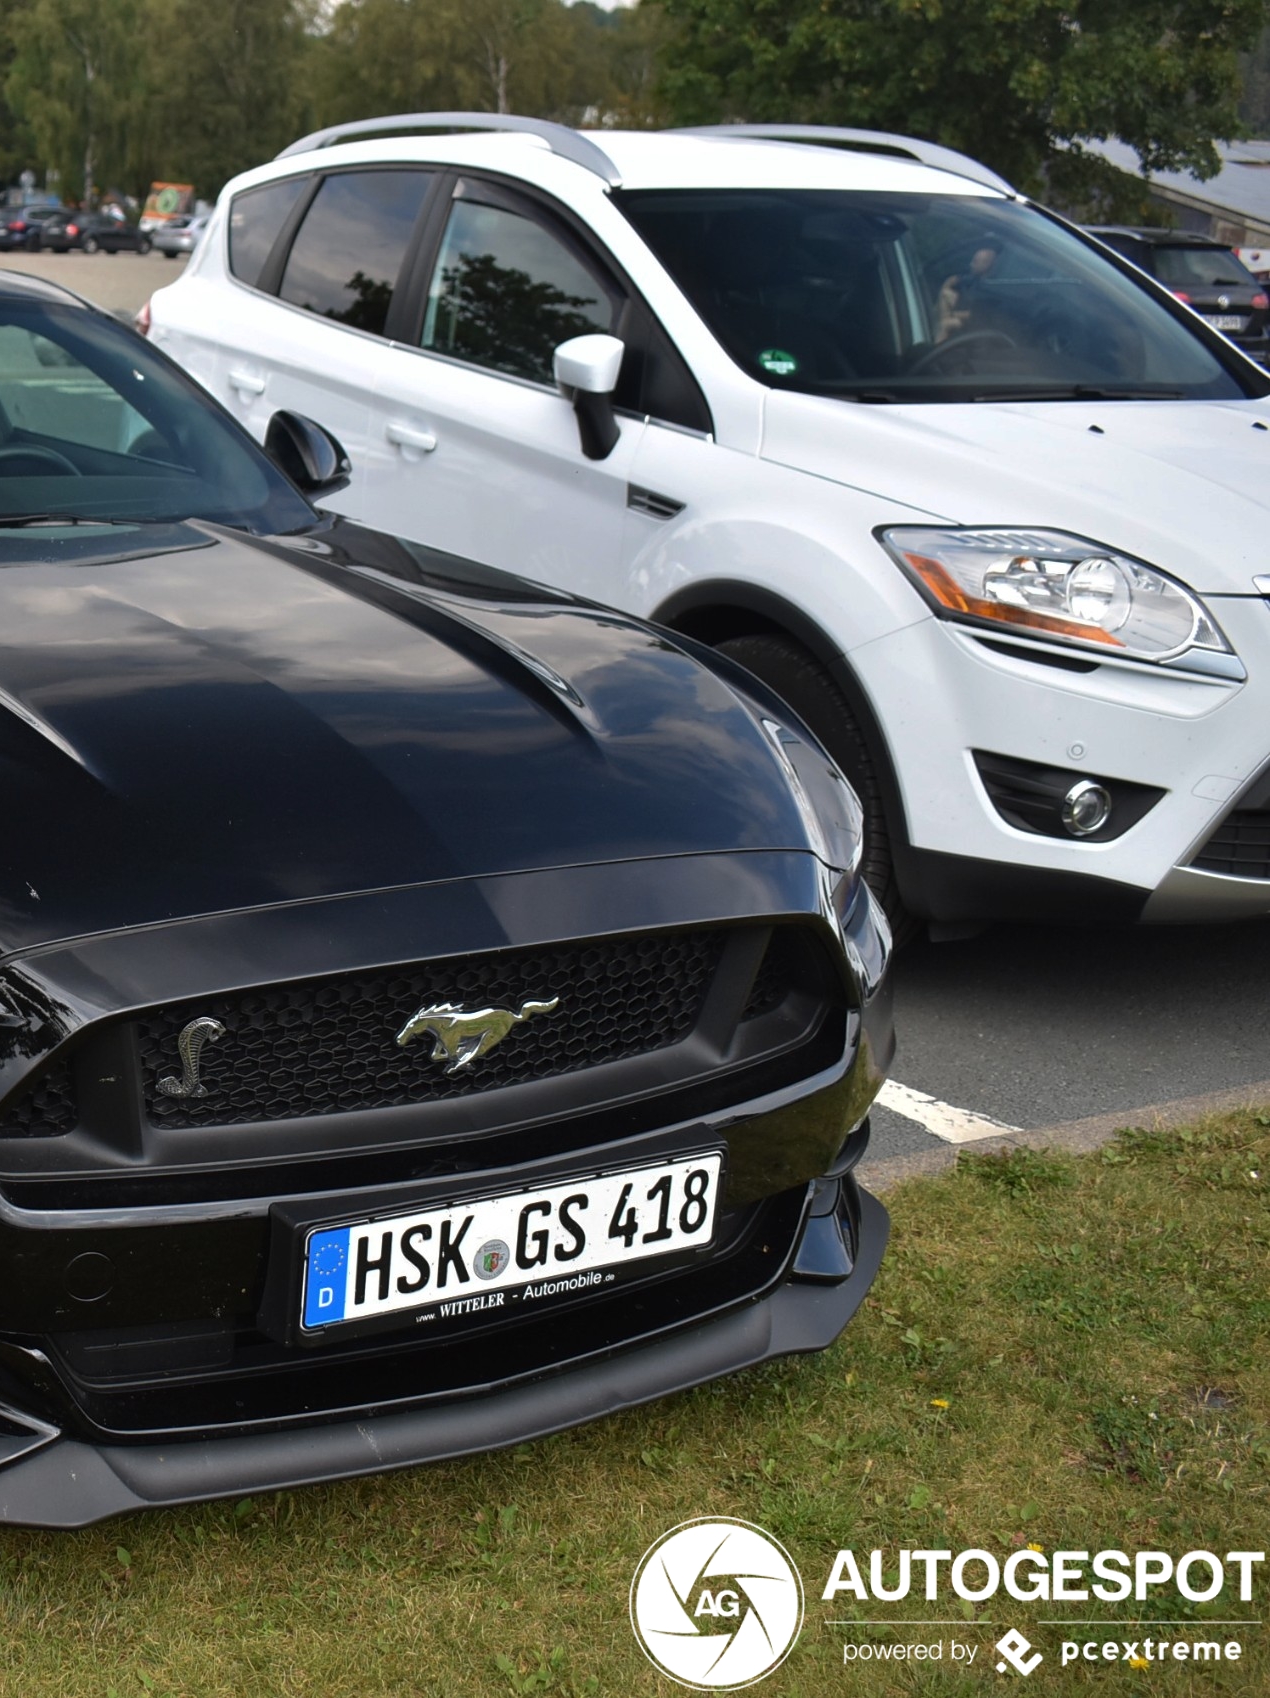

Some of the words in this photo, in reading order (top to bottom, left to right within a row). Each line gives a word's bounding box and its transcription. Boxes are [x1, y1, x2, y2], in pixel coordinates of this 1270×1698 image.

[354, 1214, 475, 1305] HSK
[515, 1193, 590, 1270] GS
[608, 1169, 710, 1248] 418
[318, 1287, 334, 1308] D
[439, 1292, 505, 1318] WITTELER
